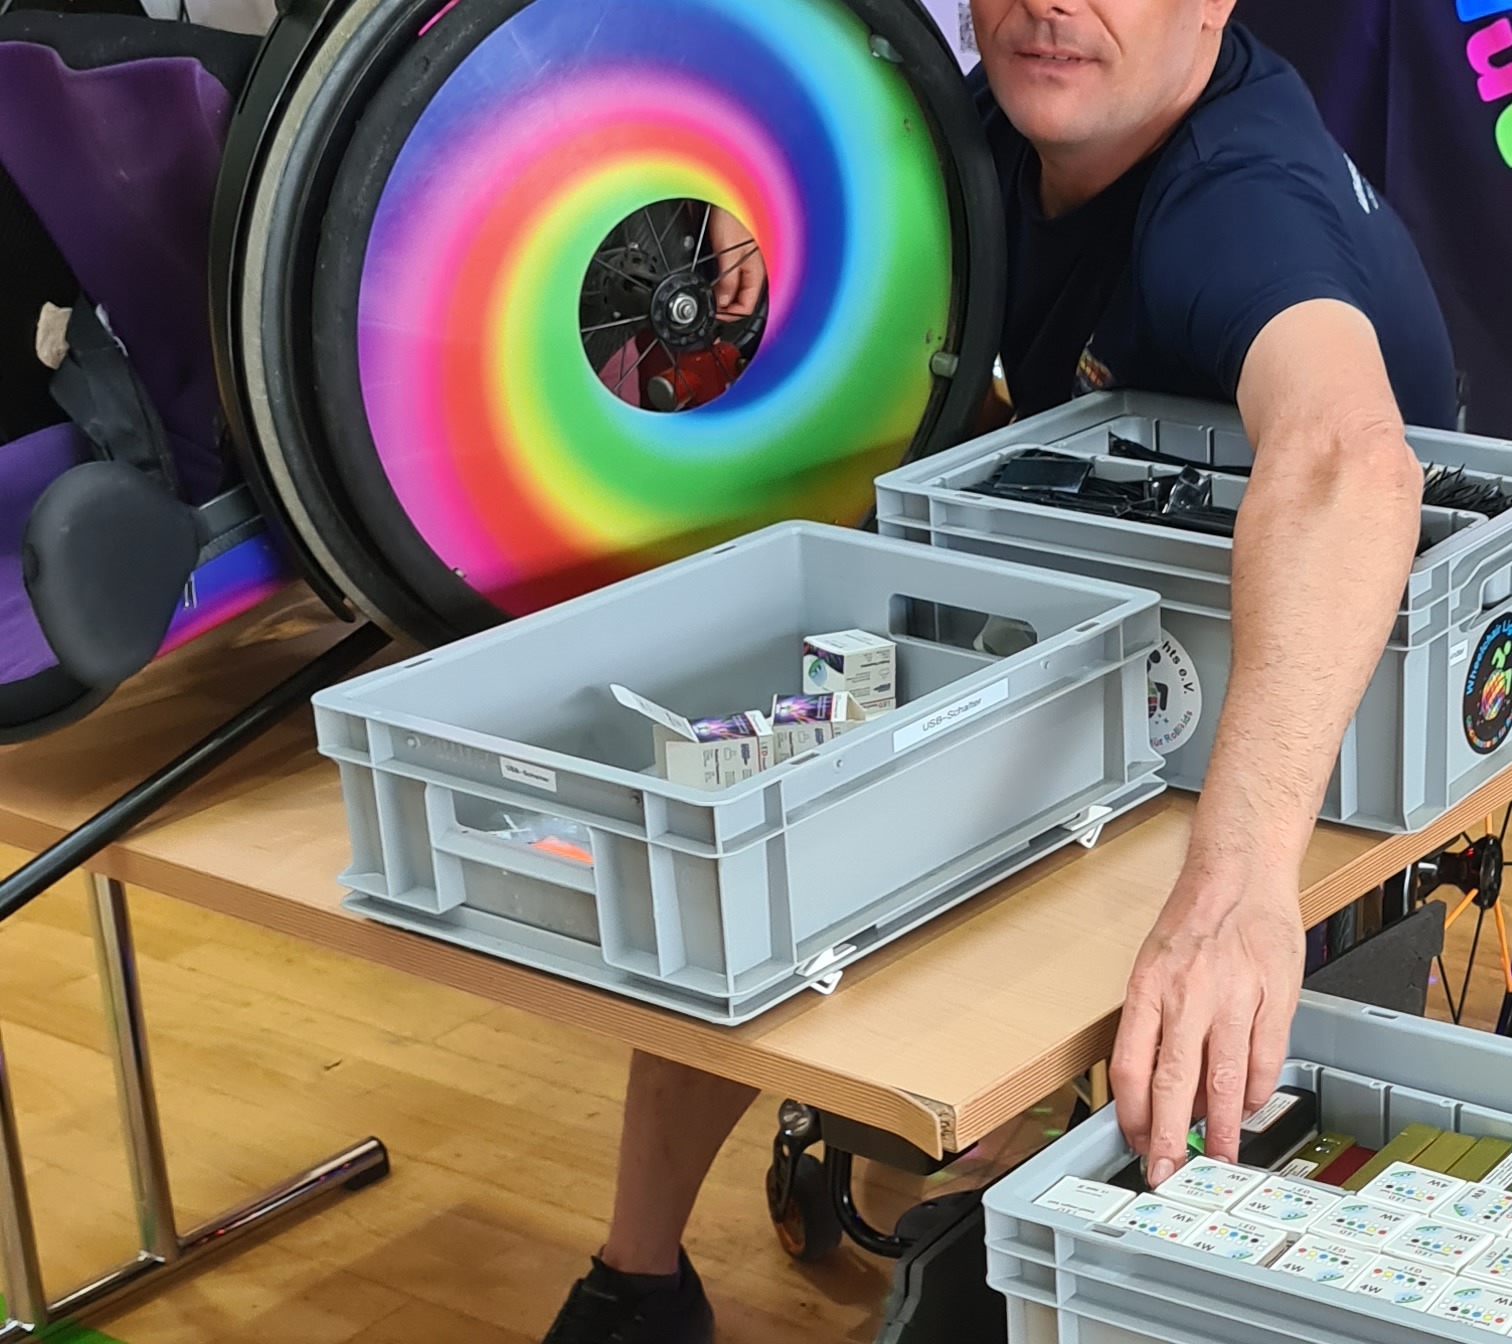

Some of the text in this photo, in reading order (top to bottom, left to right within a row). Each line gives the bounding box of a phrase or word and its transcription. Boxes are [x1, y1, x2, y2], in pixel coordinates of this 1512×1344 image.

[1162, 640, 1181, 665] hts
[1249, 1201, 1270, 1211] 4W
[1193, 1241, 1215, 1251] 4W
[1283, 1262, 1305, 1272] 4W
[1359, 1284, 1382, 1293] 4W
